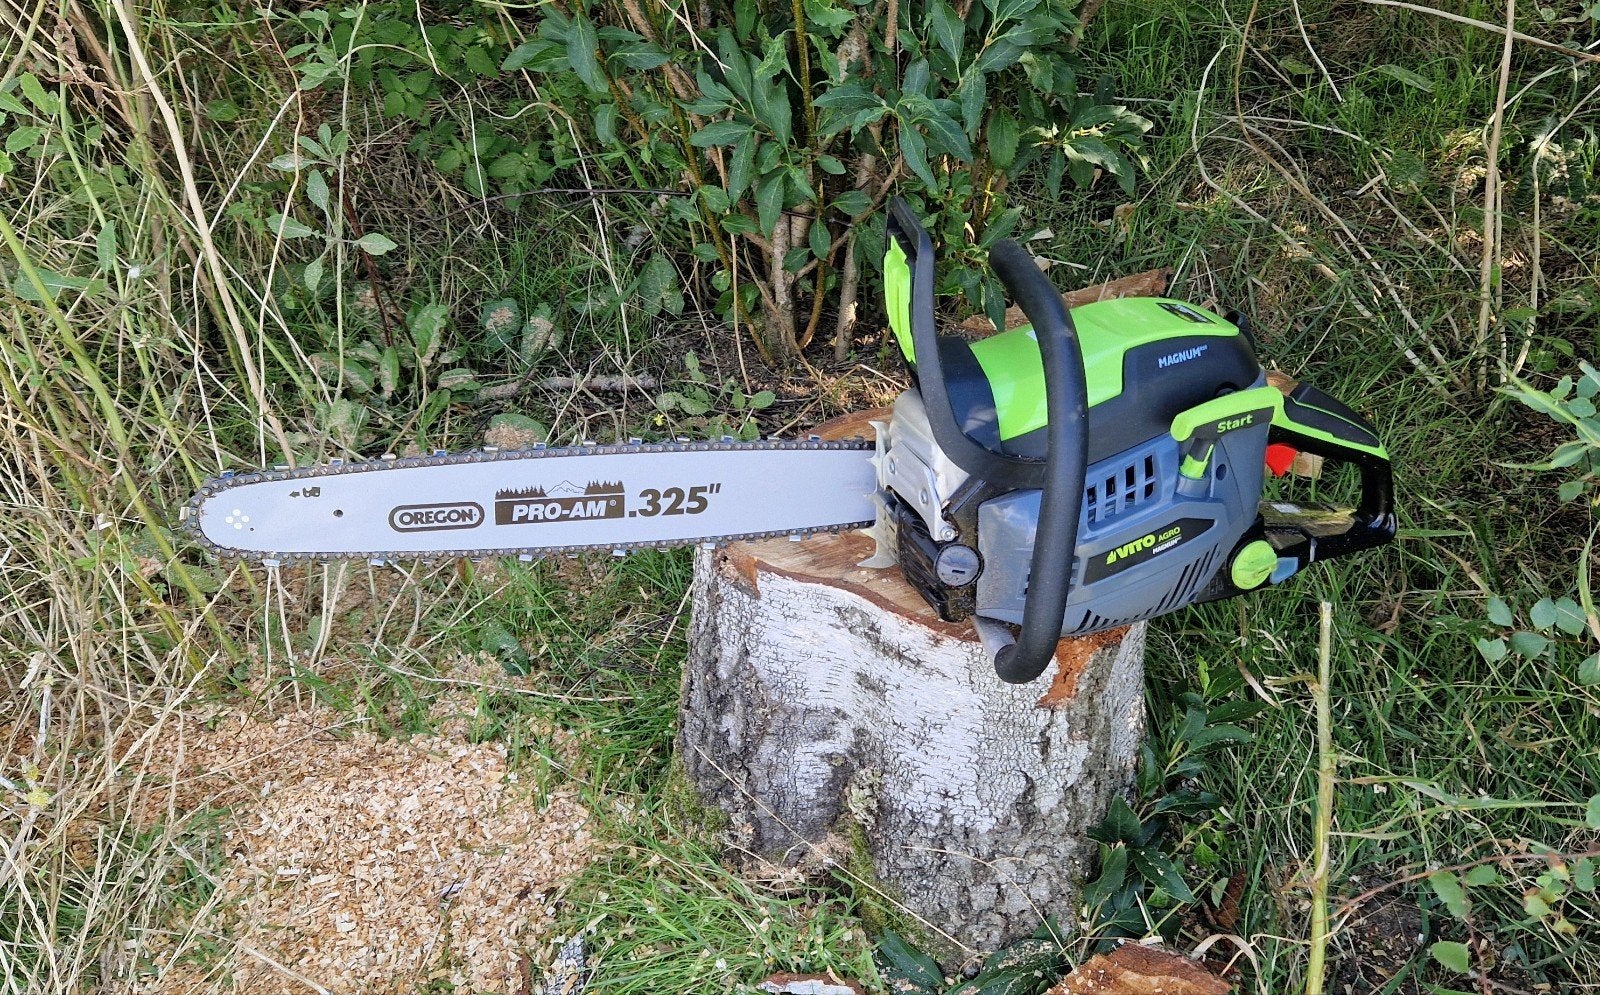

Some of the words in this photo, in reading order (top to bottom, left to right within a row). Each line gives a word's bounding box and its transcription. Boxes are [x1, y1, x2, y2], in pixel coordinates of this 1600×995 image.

[1216, 413, 1253, 434] Start
[628, 482, 721, 518] .325"
[398, 508, 474, 526] OREGON
[1115, 534, 1156, 559] VITO
[1158, 526, 1181, 542] AGRO
